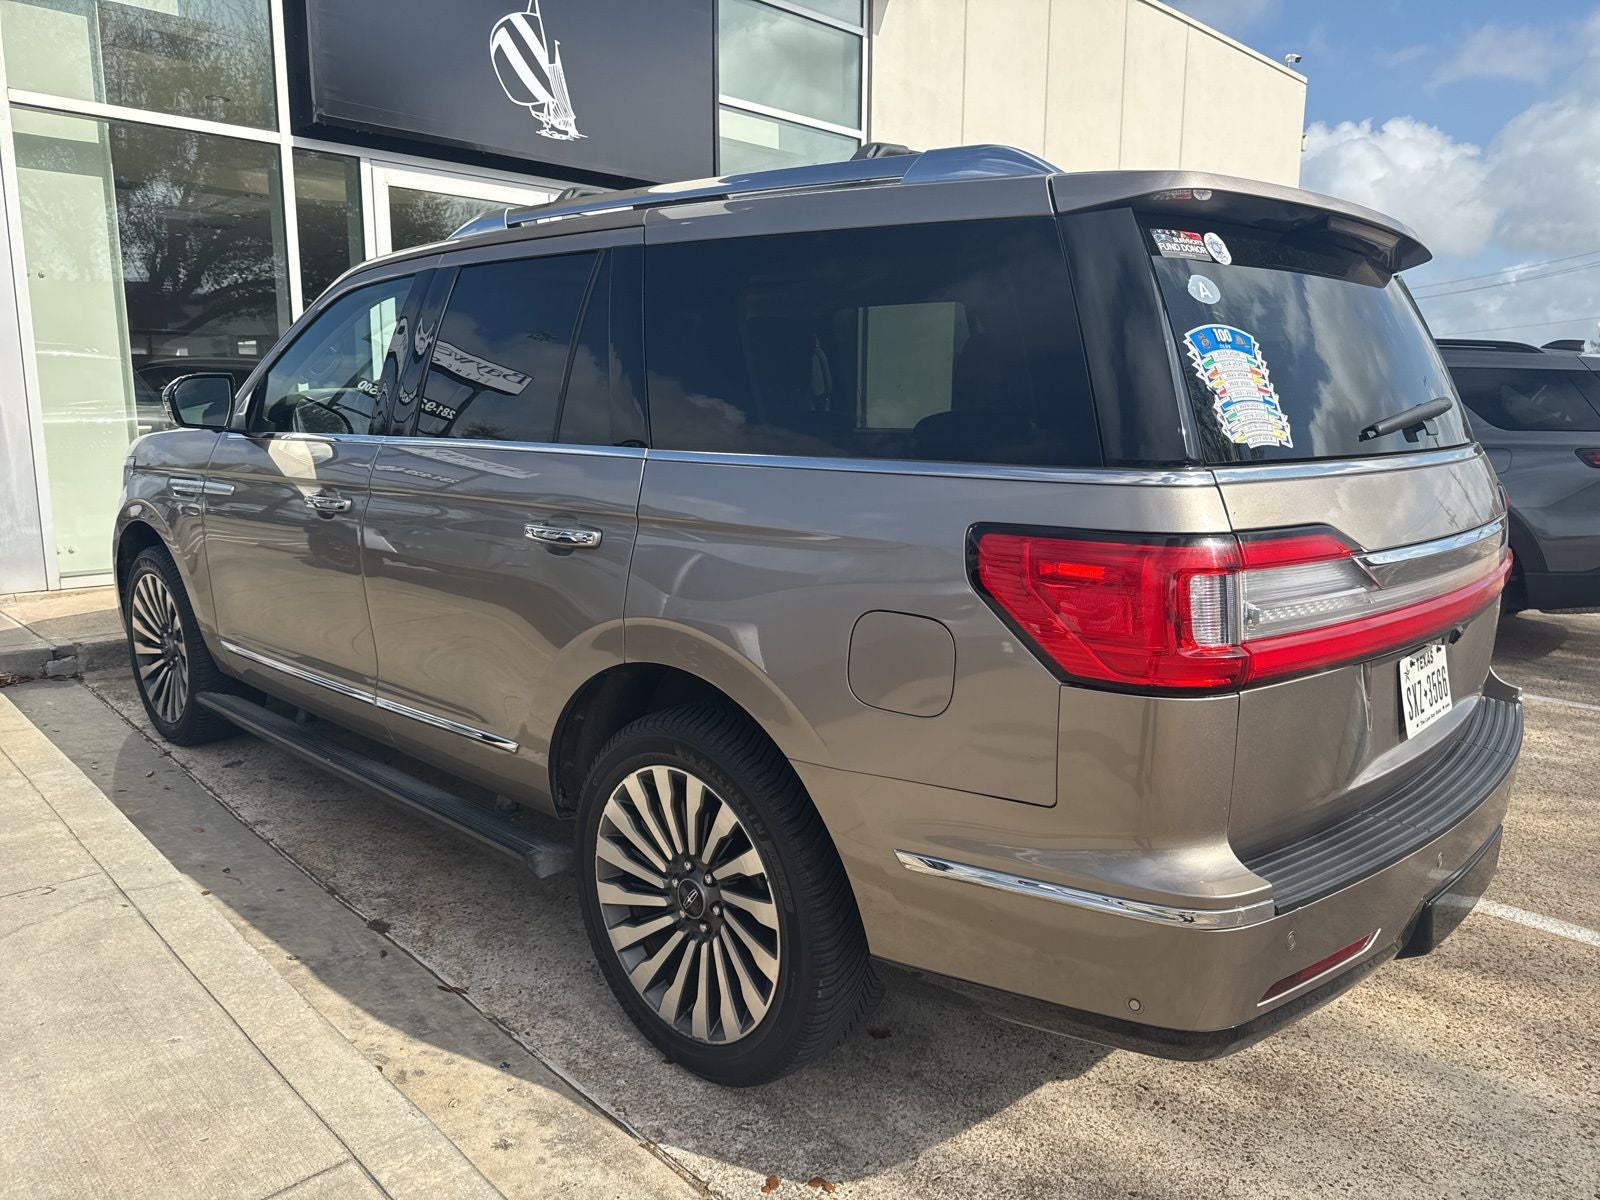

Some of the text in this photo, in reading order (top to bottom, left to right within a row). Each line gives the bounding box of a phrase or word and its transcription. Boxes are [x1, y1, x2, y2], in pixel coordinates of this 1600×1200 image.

[1158, 243, 1208, 254] FUND DONOR
[1199, 281, 1212, 298] A
[1212, 328, 1232, 342] 100
[1416, 650, 1434, 671] TEXAS
